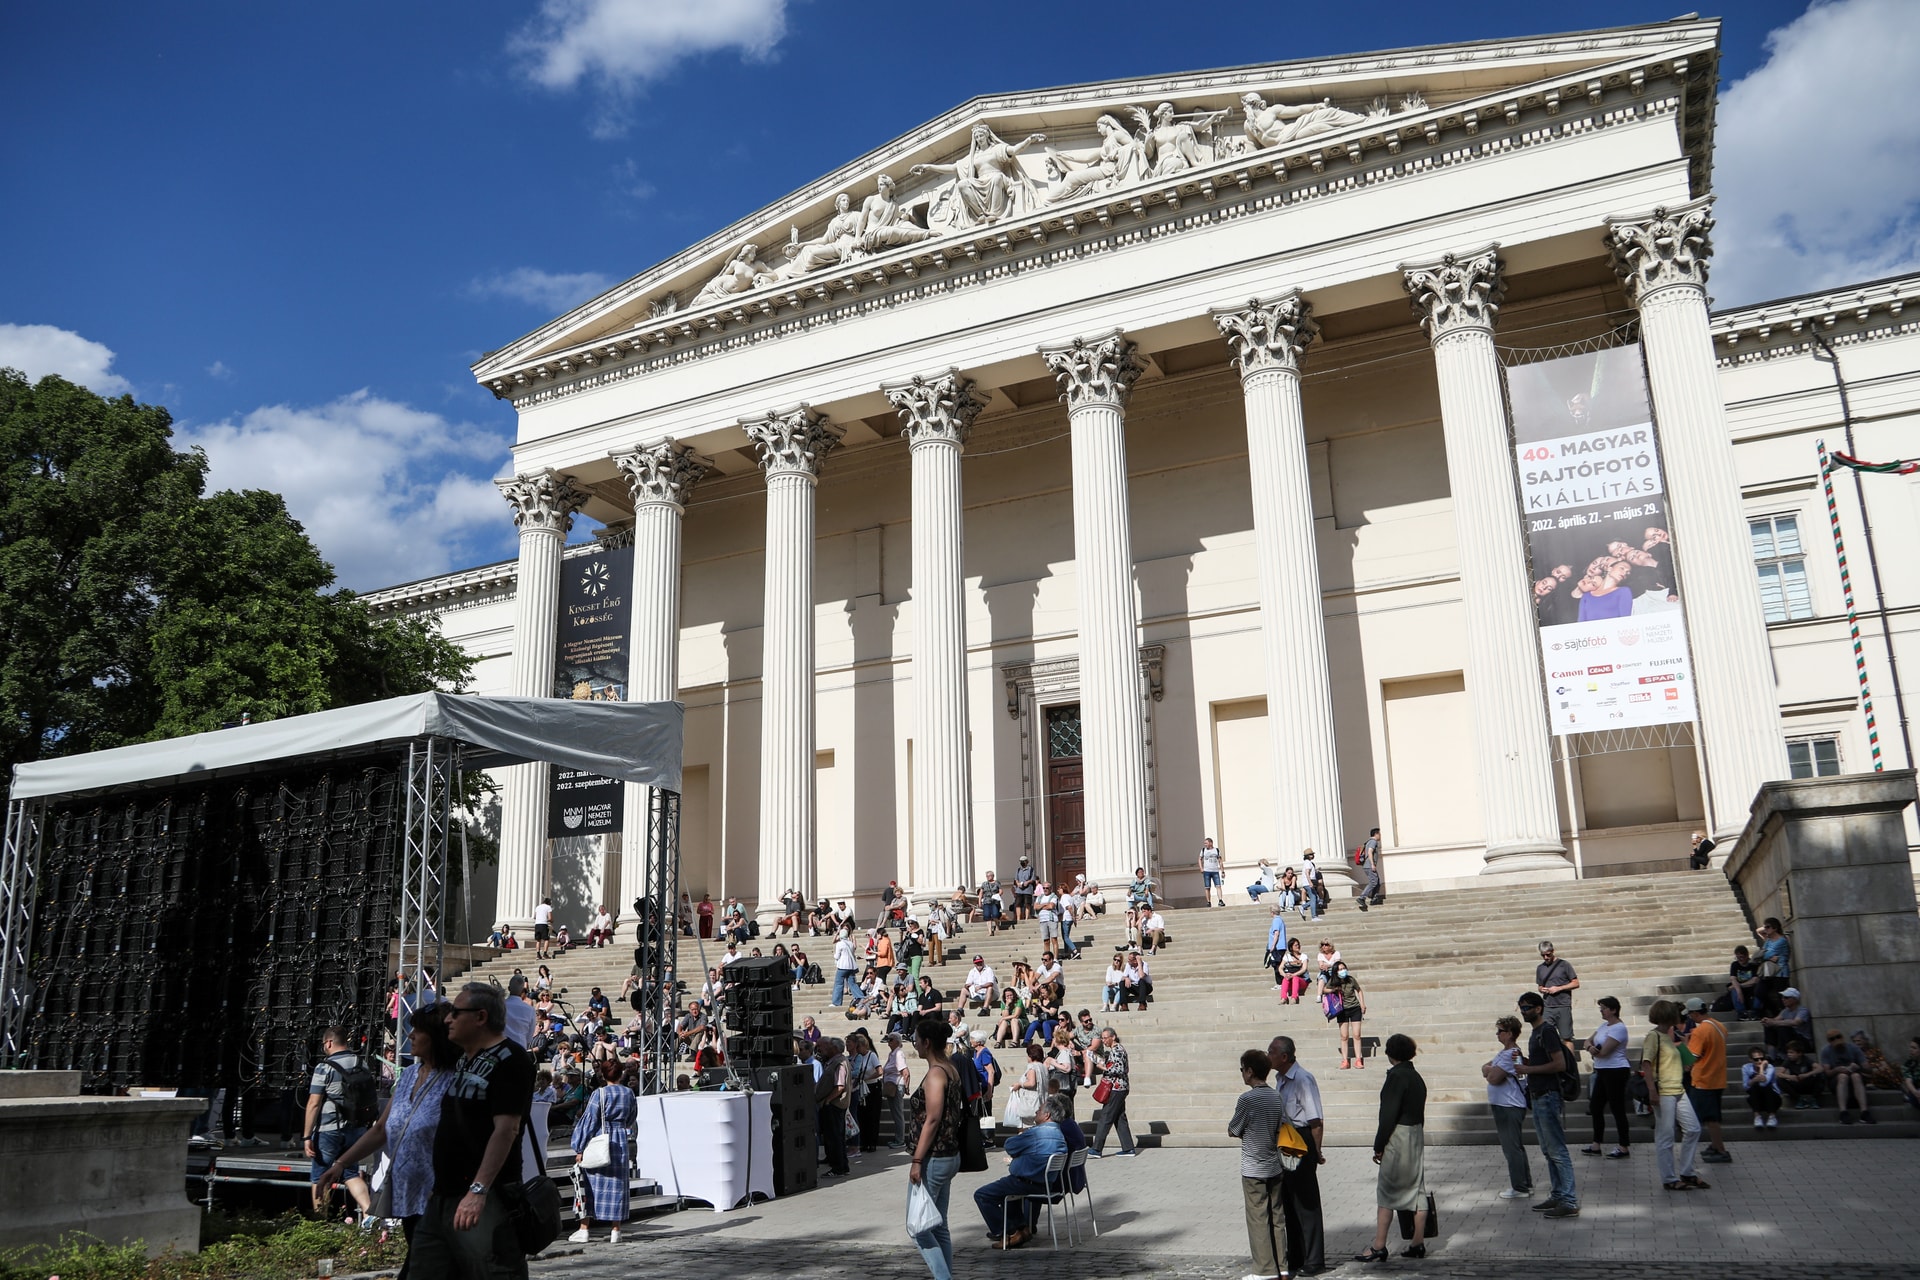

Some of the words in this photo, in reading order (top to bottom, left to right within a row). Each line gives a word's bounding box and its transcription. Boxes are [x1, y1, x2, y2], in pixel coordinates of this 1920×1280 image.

[1523, 447, 1555, 461] 40.
[1560, 430, 1648, 456] MAGYAR
[1526, 451, 1650, 485] SAJTÓFOTÓ
[1530, 477, 1655, 509] KIÁLLÍTÁS
[1532, 519, 1556, 532] 2022.
[1558, 513, 1587, 530] április
[1588, 512, 1602, 524] 27.
[1613, 505, 1642, 521] május
[1644, 503, 1659, 516] 29.
[1564, 635, 1607, 651] sajtófotó
[1649, 657, 1683, 667] FUJIFILM
[1551, 669, 1584, 679] Canon
[1645, 674, 1675, 684] SPAR
[558, 771, 576, 780] 2022.
[556, 783, 574, 791] 2022.
[574, 777, 613, 789] szeptember
[563, 806, 584, 817] MNM
[588, 803, 611, 812] MAGYAR
[588, 811, 611, 819] NEMZETI
